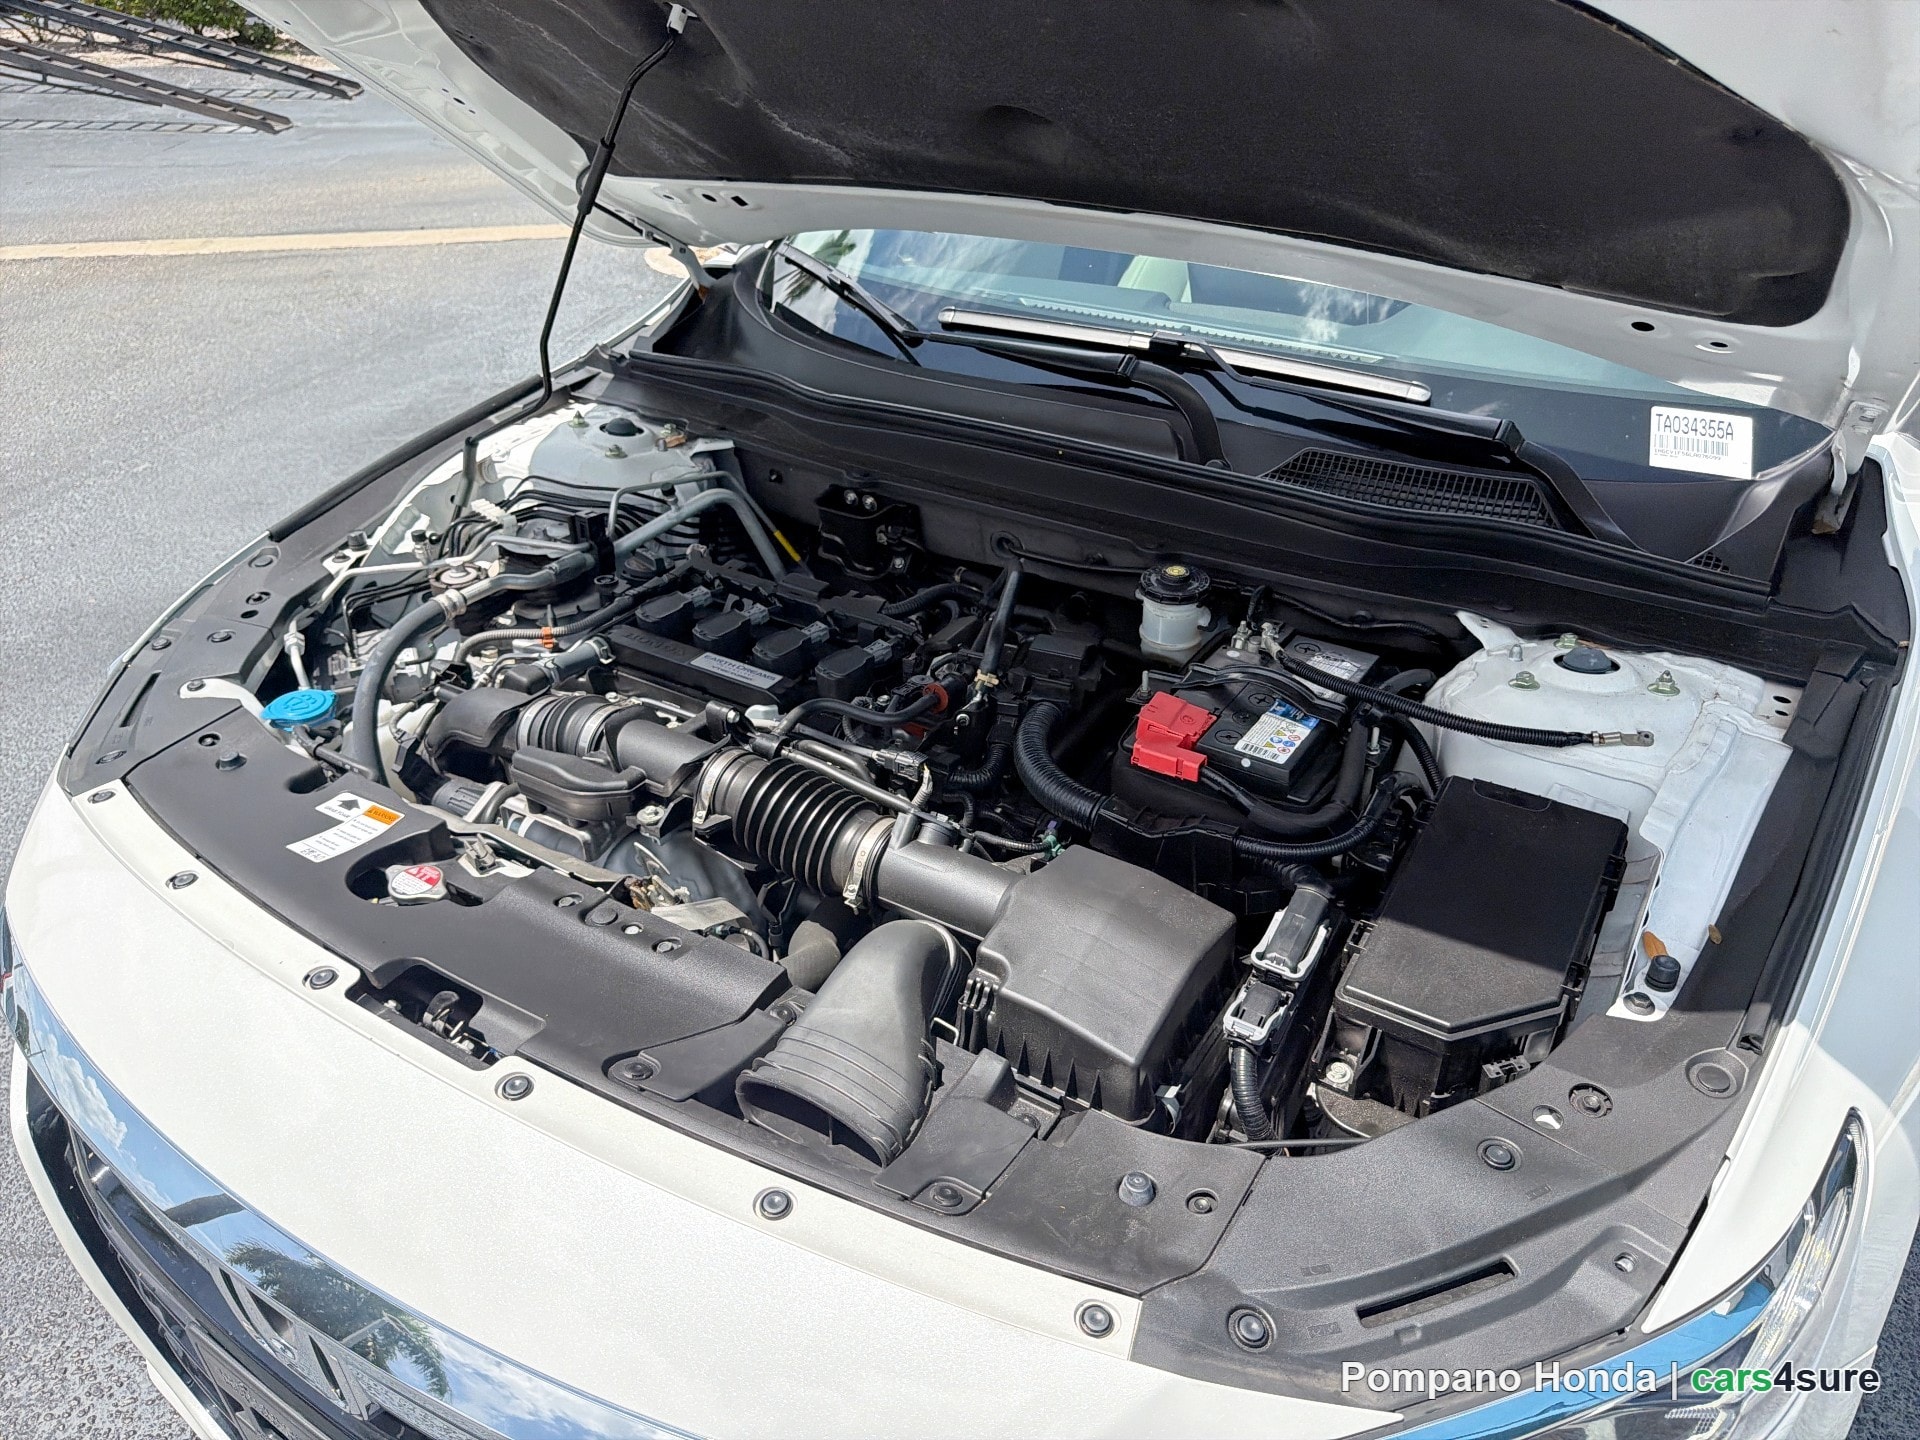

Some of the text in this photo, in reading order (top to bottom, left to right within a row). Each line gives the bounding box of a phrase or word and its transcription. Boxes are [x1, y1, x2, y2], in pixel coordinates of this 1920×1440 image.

[1656, 414, 1733, 440] TA034355A
[703, 655, 736, 669] EARTH
[736, 665, 776, 681] DREAMS
